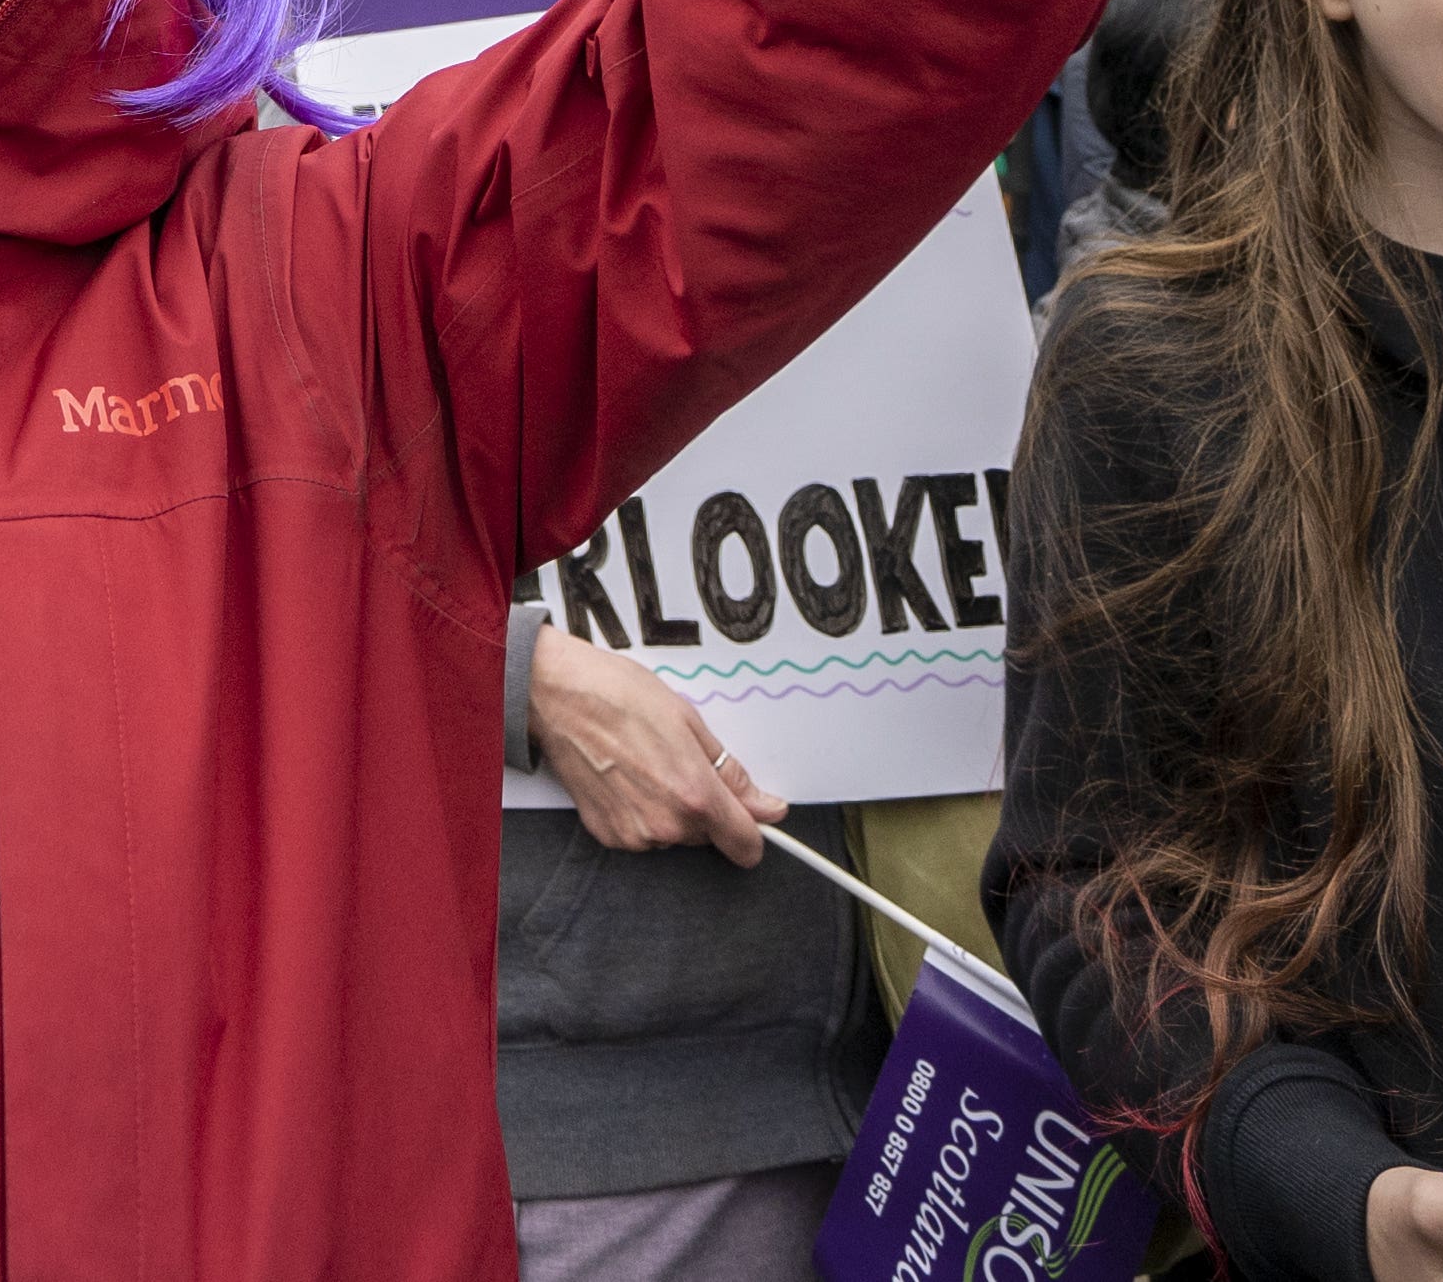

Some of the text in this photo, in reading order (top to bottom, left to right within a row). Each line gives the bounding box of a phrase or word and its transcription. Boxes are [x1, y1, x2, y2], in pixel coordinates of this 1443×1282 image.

[513, 468, 1010, 650] RLOOKE
[865, 1058, 936, 1217] 0800 0 857 857
